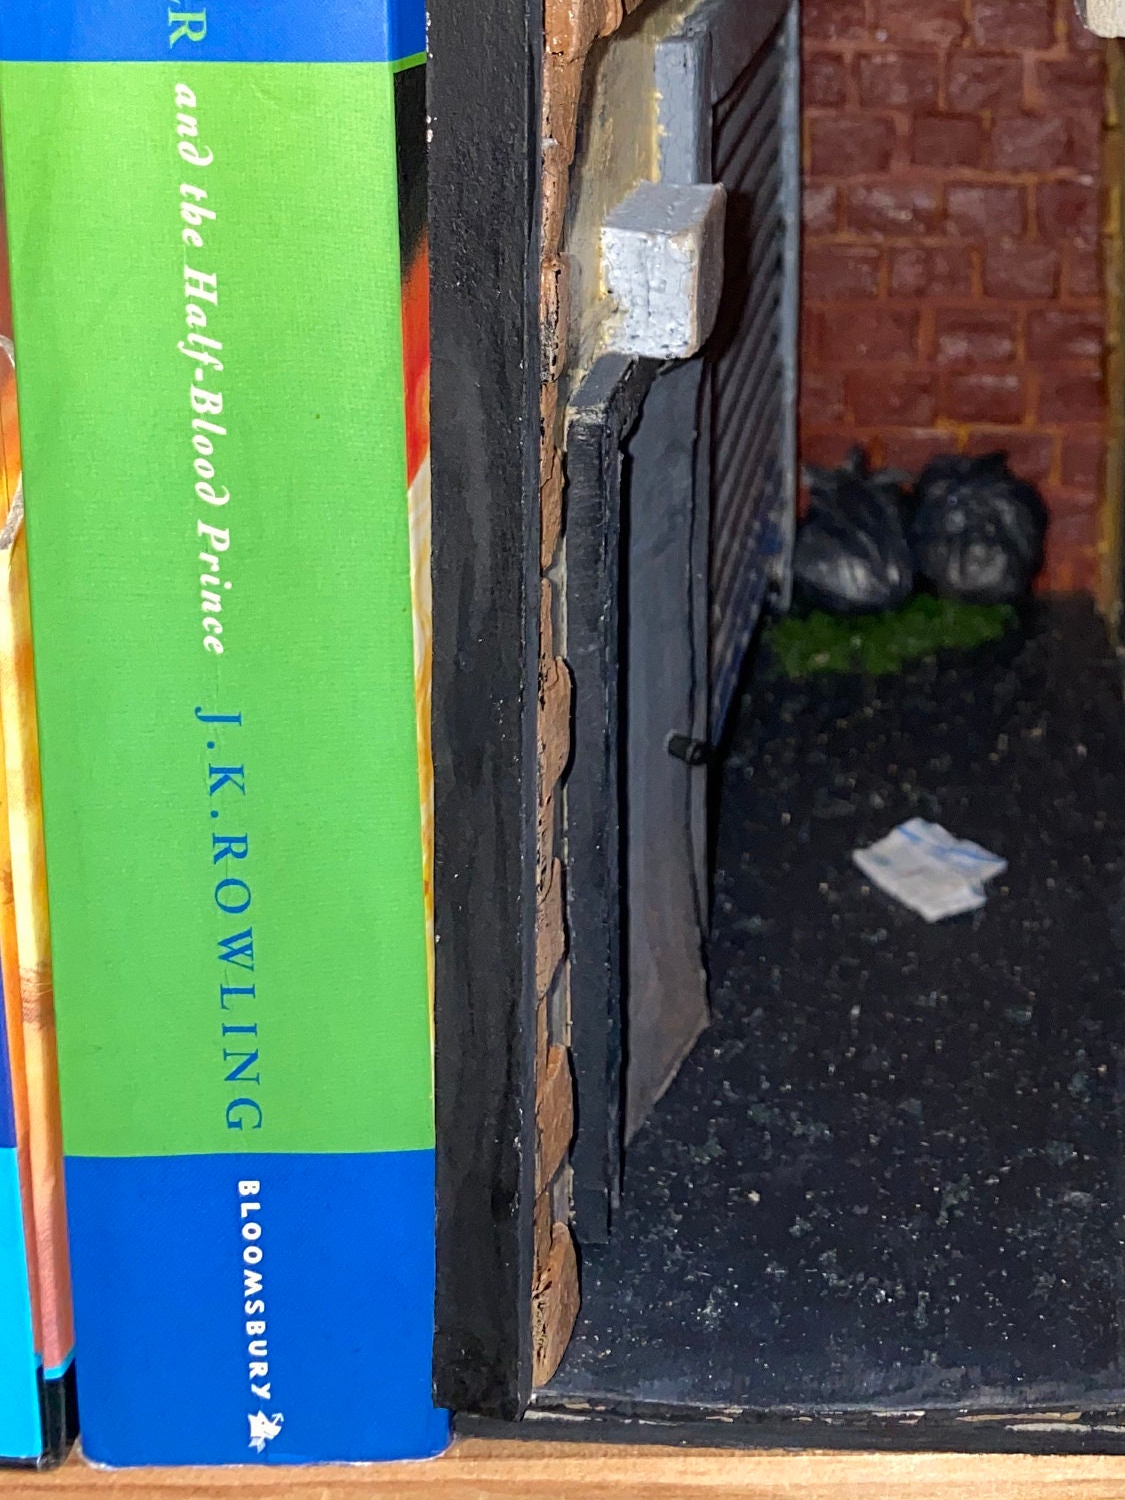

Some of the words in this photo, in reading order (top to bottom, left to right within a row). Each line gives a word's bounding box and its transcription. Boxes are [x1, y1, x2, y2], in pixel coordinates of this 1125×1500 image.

[174, 82, 214, 167] and
[179, 181, 217, 249] the
[178, 263, 231, 508] Half-Blood
[197, 518, 233, 656] Prince
[237, 1178, 273, 1401] BLOOMSBURY
